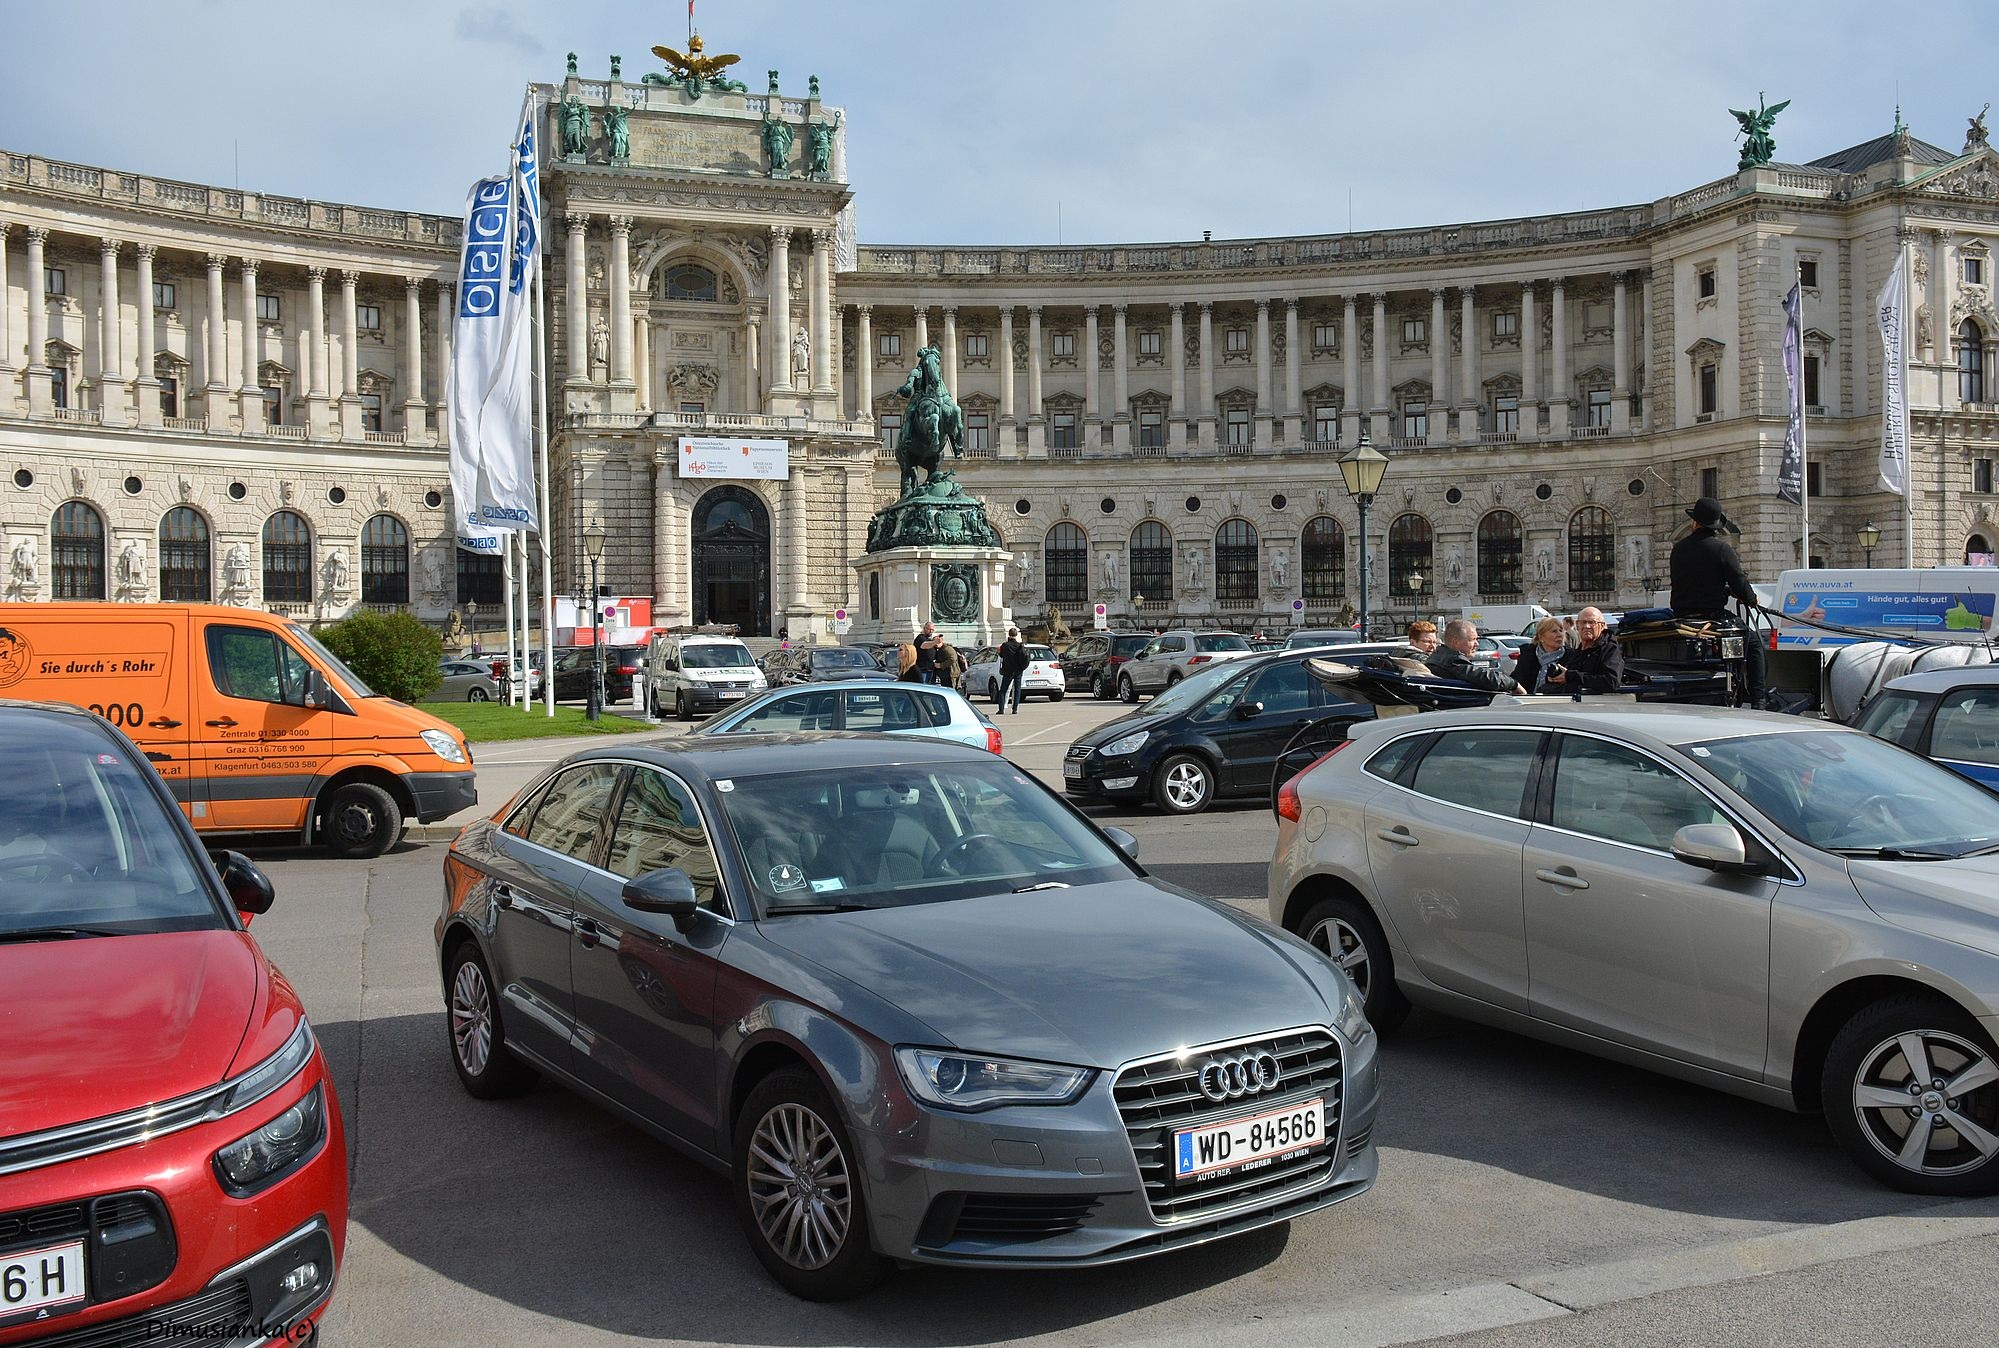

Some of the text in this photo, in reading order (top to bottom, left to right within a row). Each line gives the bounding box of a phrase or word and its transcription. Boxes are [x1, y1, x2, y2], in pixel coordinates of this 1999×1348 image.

[1867, 595, 1893, 603] Hände
[1894, 596, 1910, 604] gut,
[1930, 596, 1948, 604] gut!
[40, 661, 61, 674] Sie
[122, 660, 156, 672] Rohr
[220, 730, 256, 738] Zentrale
[288, 729, 310, 737] 4000
[226, 746, 247, 754] Graz
[289, 744, 305, 752] 900
[214, 762, 259, 772] Klagenfurt
[301, 760, 317, 769] 580
[1198, 1110, 1316, 1165] WD-84566
[1182, 1158, 1190, 1168] A
[1197, 1170, 1216, 1182] AUTO
[1241, 1158, 1272, 1171] LEDERER
[1294, 1147, 1310, 1159] WIEN
[4, 1254, 66, 1302] 6 H
